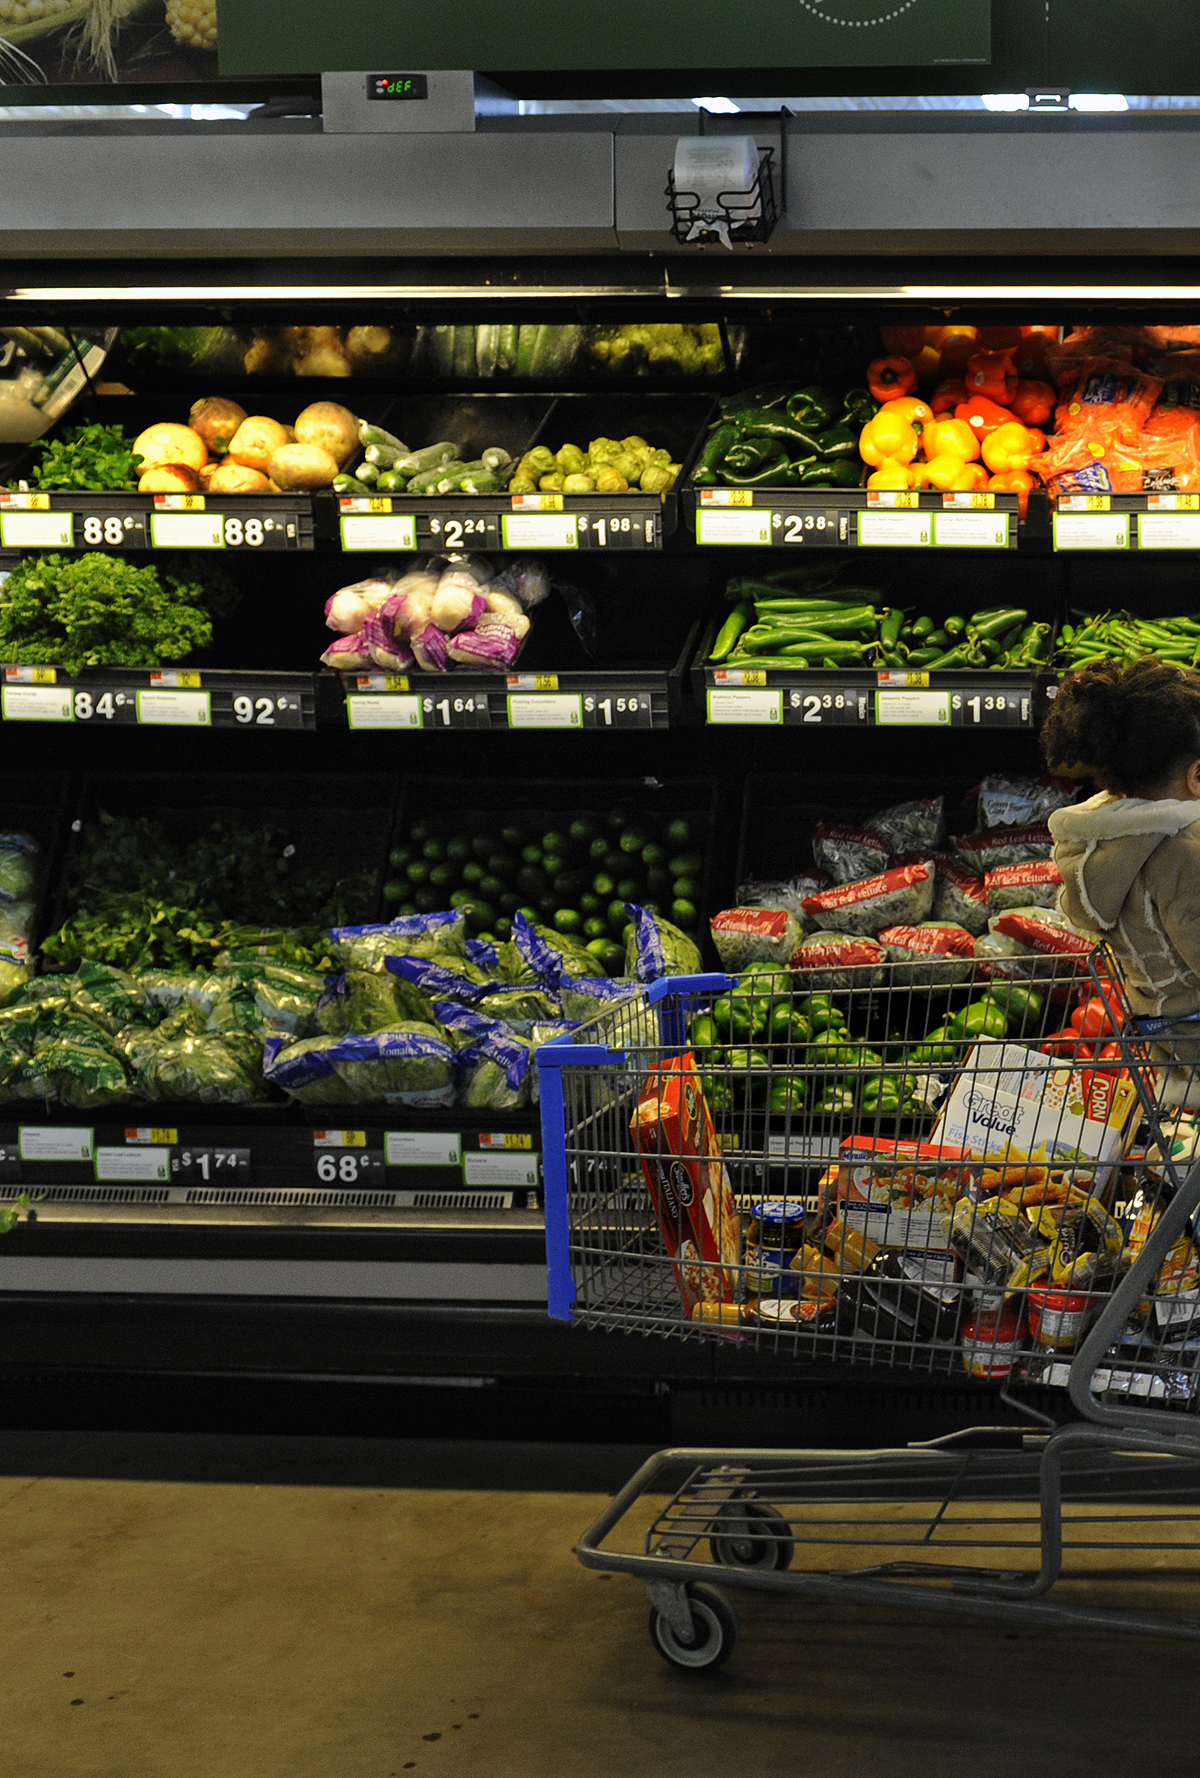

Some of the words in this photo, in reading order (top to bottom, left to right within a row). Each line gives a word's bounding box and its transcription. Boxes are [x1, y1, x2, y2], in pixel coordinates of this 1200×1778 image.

[1021, 873, 1053, 883] Lettuce
[963, 1089, 1025, 1125] Great
[1087, 1076, 1110, 1120] CORN
[971, 1111, 1018, 1137] Value
[660, 1179, 680, 1220] ITALIANO
